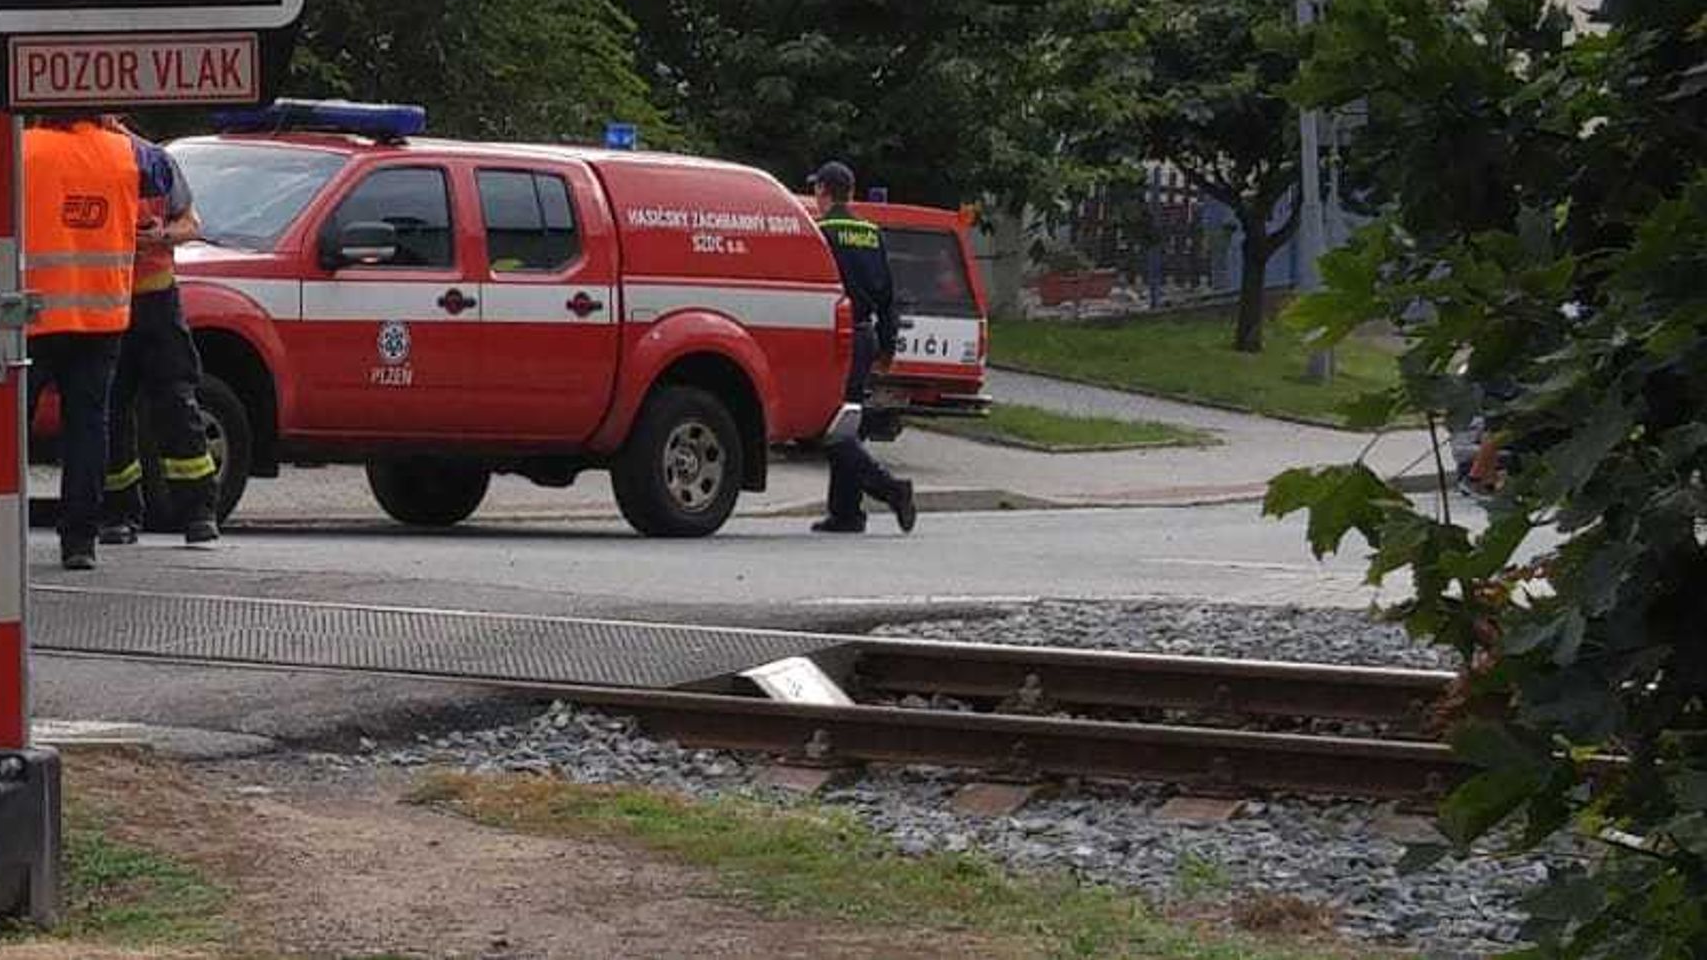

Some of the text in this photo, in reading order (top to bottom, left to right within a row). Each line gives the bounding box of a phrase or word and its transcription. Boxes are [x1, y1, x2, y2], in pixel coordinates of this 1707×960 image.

[27, 48, 242, 93] POZOR VLAK
[897, 333, 948, 356] SIČI
